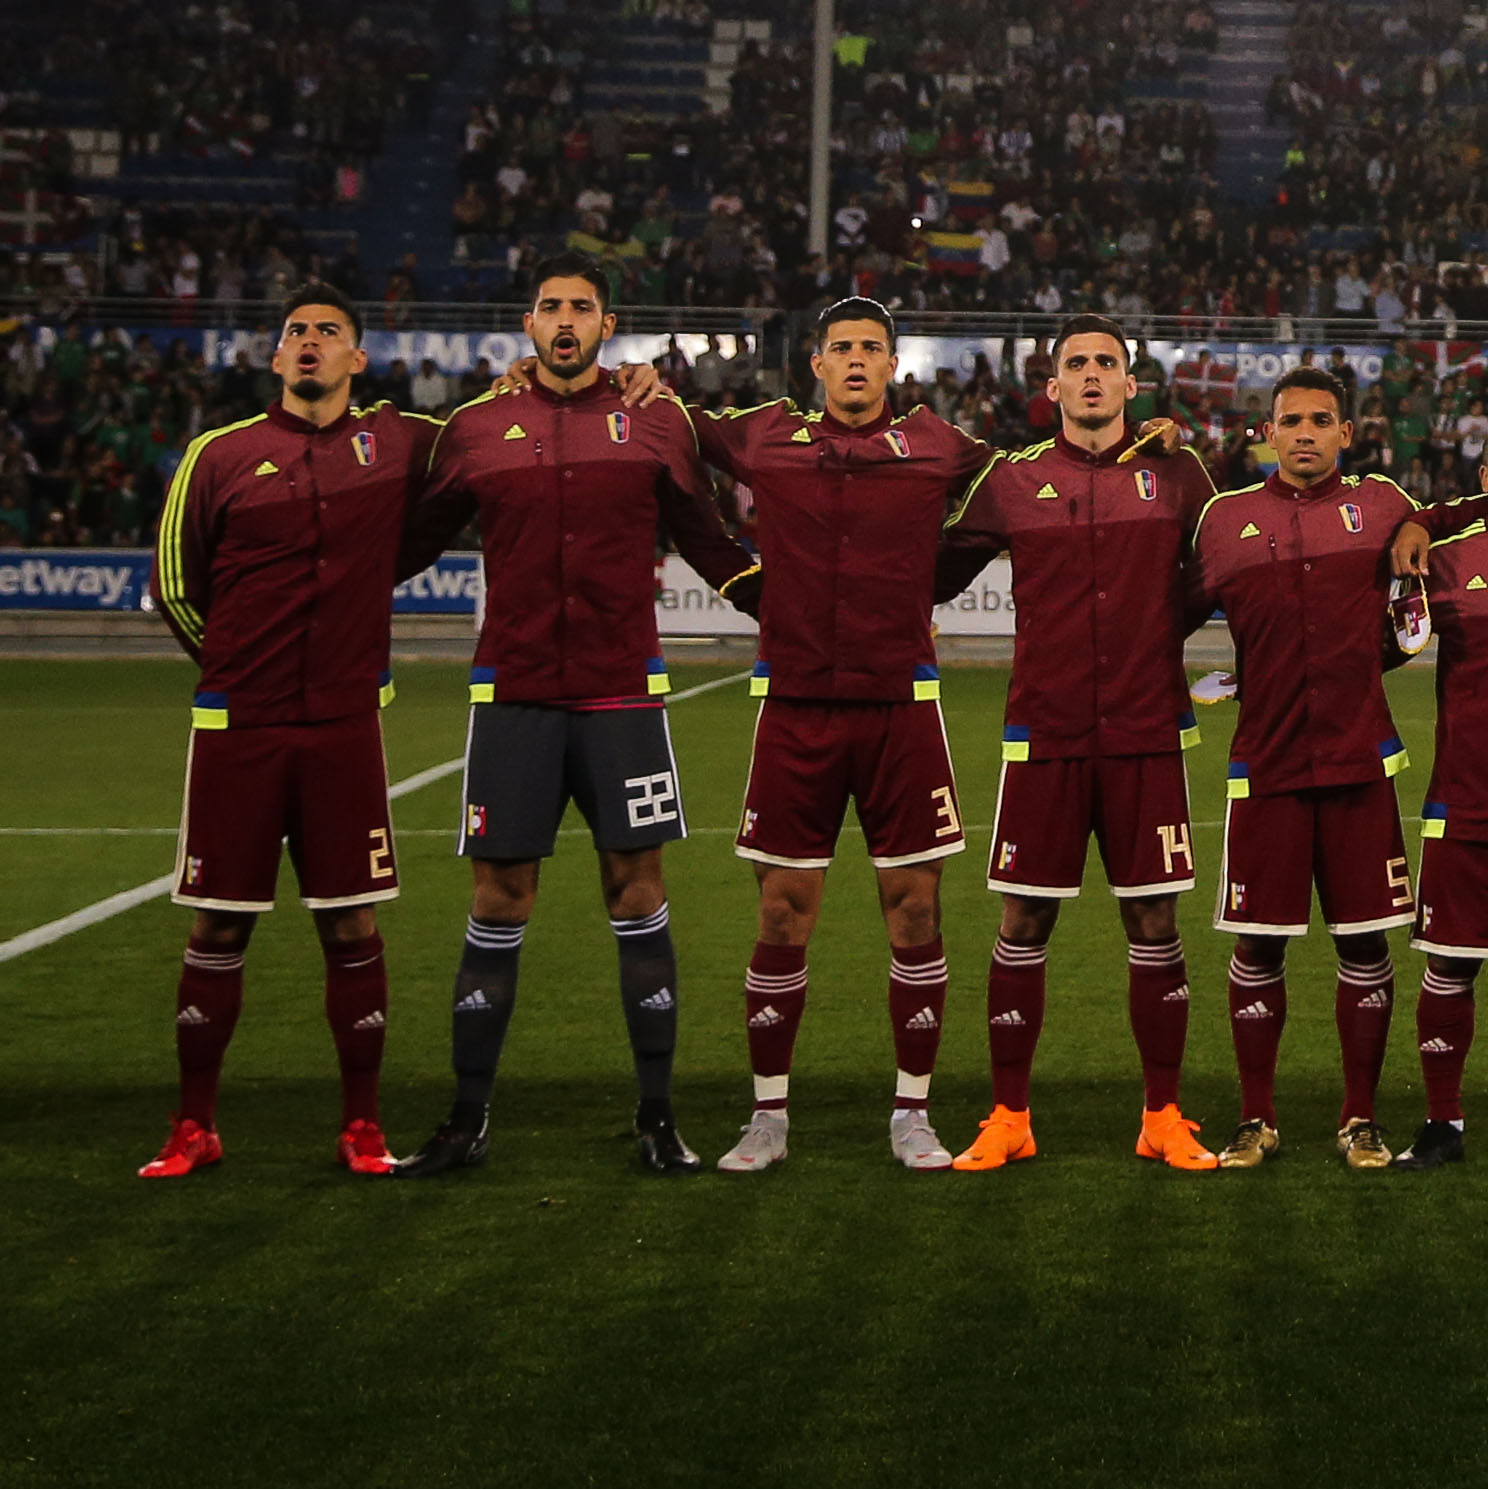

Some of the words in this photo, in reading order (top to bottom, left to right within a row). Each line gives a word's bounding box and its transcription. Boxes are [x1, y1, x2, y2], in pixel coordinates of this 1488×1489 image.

[624, 770, 679, 828] 22
[930, 785, 961, 838] 3
[368, 827, 394, 879] 2
[1156, 823, 1191, 874] 14
[1386, 856, 1414, 907] 5
